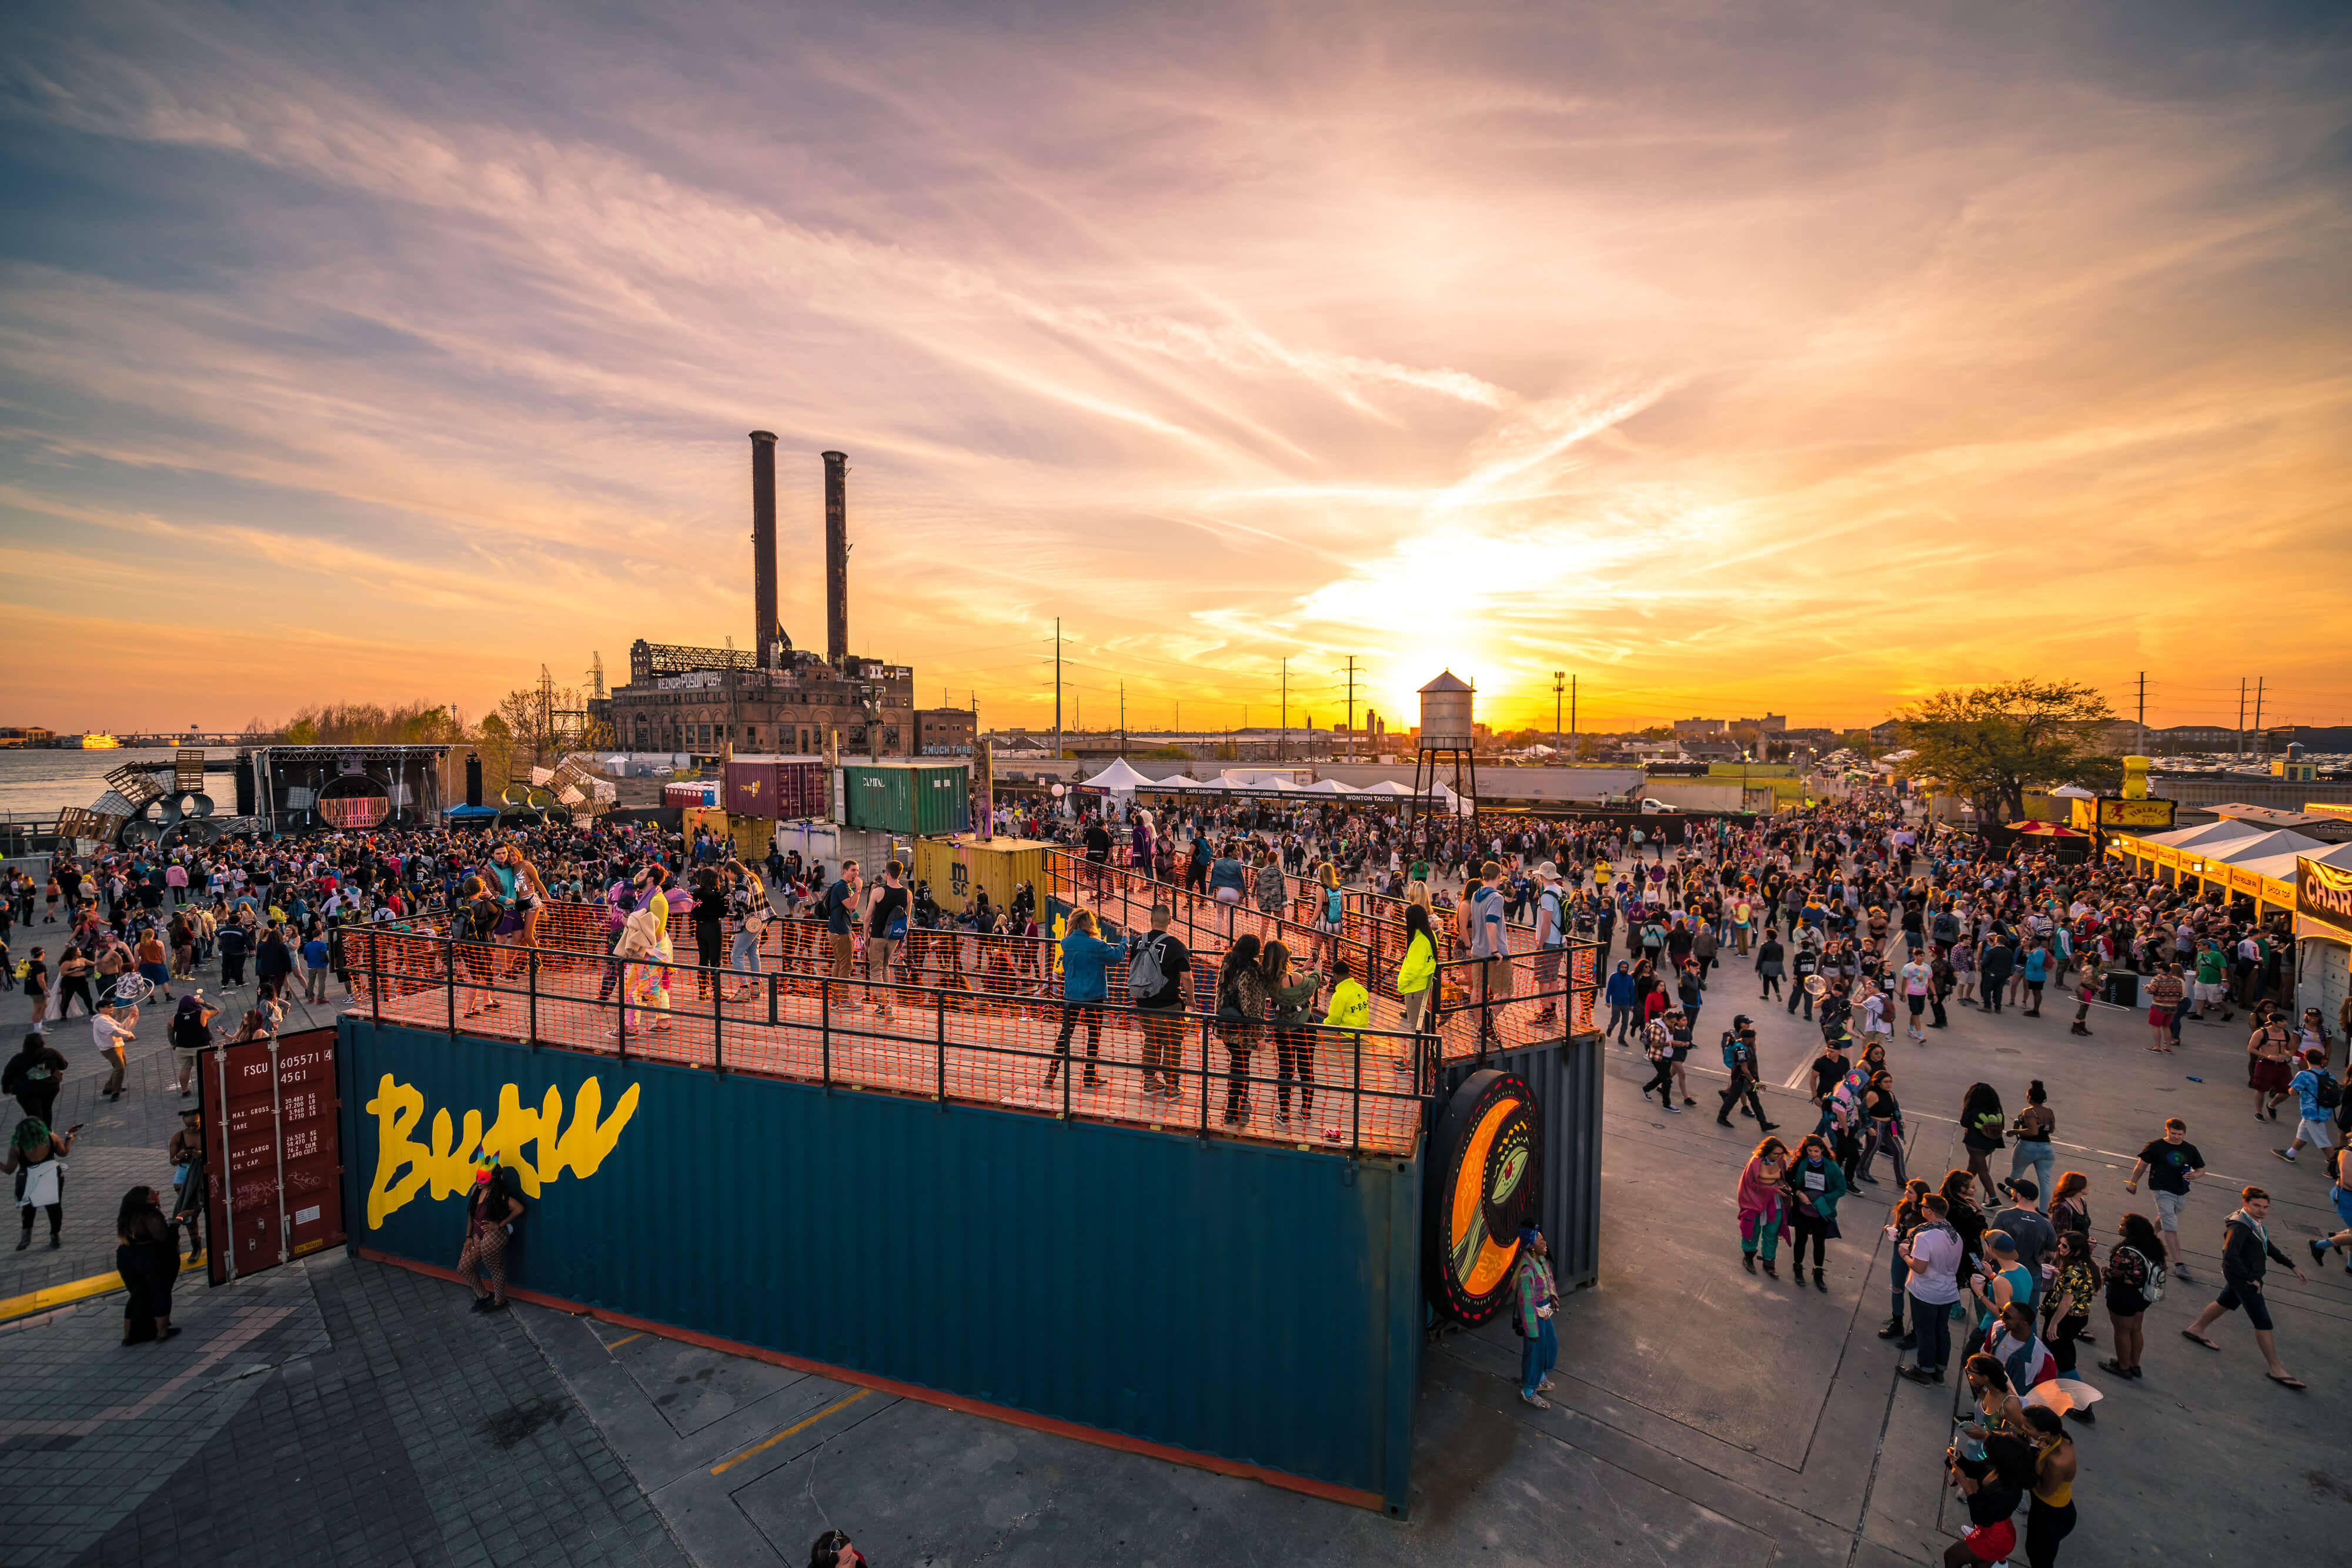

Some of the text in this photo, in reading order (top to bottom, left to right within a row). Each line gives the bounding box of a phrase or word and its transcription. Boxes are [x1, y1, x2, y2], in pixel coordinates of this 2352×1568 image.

[2267, 885, 2290, 898] SHOCK TOP
[244, 1049, 332, 1077] FSCU 605571 4
[280, 1070, 306, 1084] 45G1
[285, 1095, 303, 1105] 30.480
[285, 1101, 304, 1110] 67.200
[250, 1106, 269, 1115] GROSS
[289, 1107, 304, 1115] 3.960
[289, 1113, 305, 1121] 8.730
[233, 1122, 248, 1131] TARE
[286, 1132, 305, 1142] 26.520
[287, 1138, 305, 1148] 58.470
[232, 1145, 269, 1159] MAX. CARGO
[288, 1151, 302, 1159] 2.690
[247, 1159, 260, 1167] CAP.
